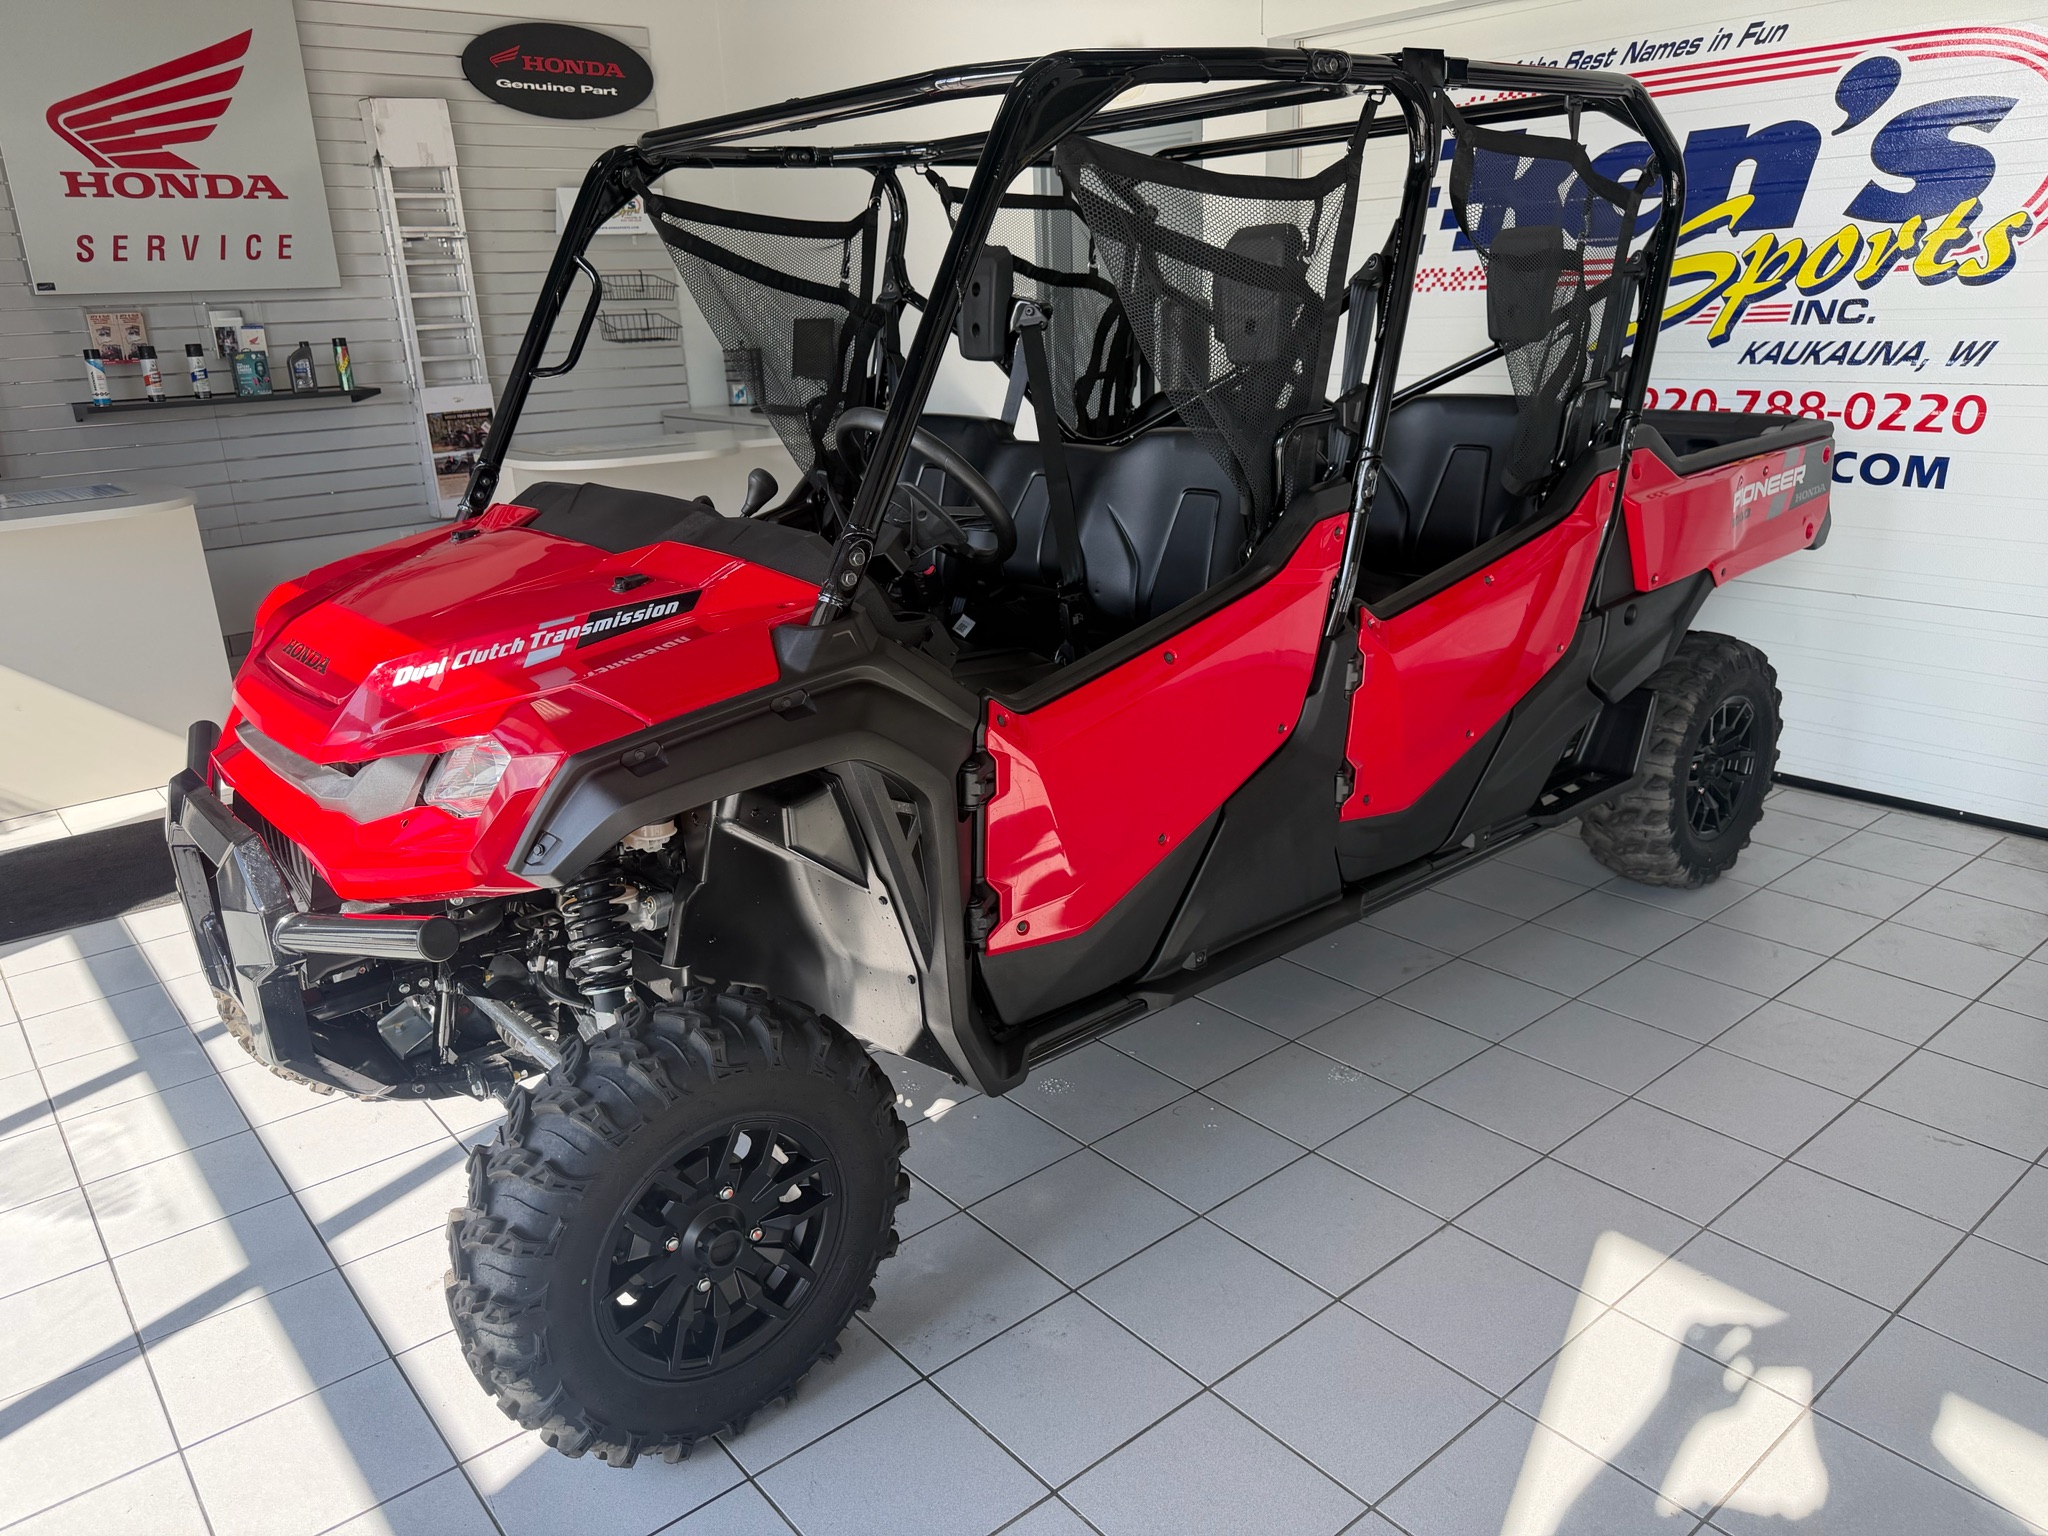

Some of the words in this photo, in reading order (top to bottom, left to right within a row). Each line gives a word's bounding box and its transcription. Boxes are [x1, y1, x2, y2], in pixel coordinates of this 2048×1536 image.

[1564, 49, 1618, 71] Best
[1619, 34, 1703, 65] Names
[1707, 27, 1734, 52] in
[1738, 20, 1790, 47] Fun
[521, 55, 626, 79] HONDA
[496, 78, 576, 93] Genuine
[580, 85, 618, 96] Part
[59, 171, 289, 200] HONDA
[76, 233, 293, 263] SERVICE
[1588, 194, 2033, 357] Sports
[1790, 298, 1876, 326] INC.
[1737, 340, 1930, 373] KAUKAUNA,
[1945, 340, 2000, 368] WI
[1733, 464, 1807, 513] PIONEER
[1794, 483, 1827, 503] HONDA
[282, 638, 330, 675] HONDA
[391, 656, 448, 688] Dual
[451, 637, 526, 671] Clutch
[529, 599, 681, 649] Transmission
